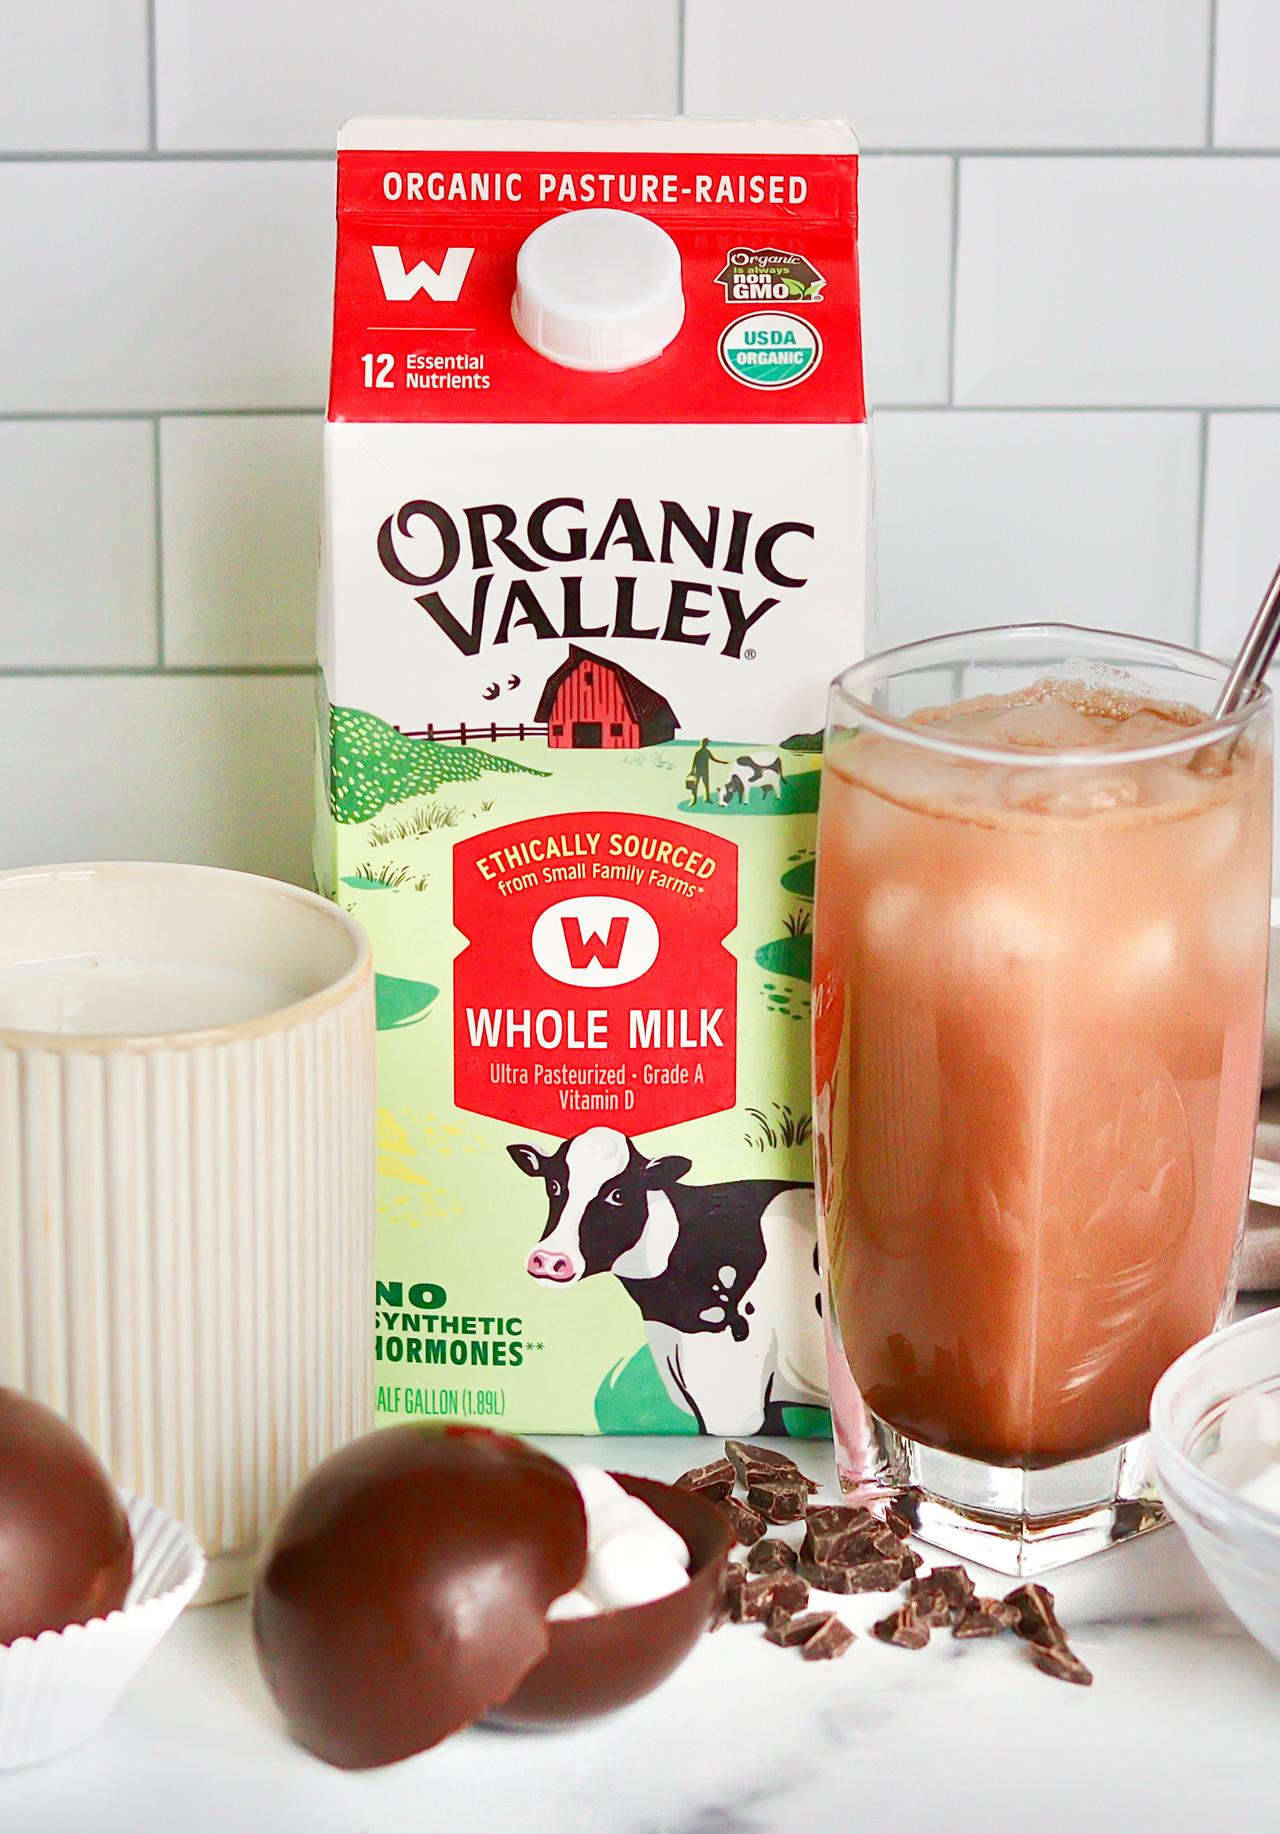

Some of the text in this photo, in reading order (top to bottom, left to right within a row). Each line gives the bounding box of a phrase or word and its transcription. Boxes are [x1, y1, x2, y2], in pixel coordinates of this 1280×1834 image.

[382, 171, 808, 204] ORGANIC PASTURE-RAISED
[371, 245, 475, 301] W
[730, 252, 801, 267] Organic
[747, 266, 790, 275] always
[733, 274, 772, 284] non
[733, 283, 789, 299] GMO
[744, 331, 796, 345] USDA
[361, 353, 484, 388] 12 Essential
[736, 351, 804, 365] ORGANIC
[406, 371, 491, 389] Nutrients
[377, 497, 815, 588] ORGANIC
[475, 833, 717, 881] ETHICALLY SOURCED
[498, 872, 539, 897] from
[542, 862, 586, 884] Small
[592, 862, 644, 885] Family
[560, 916, 629, 969] W
[466, 1007, 725, 1049] WHOLE MILK
[490, 1063, 704, 1086] Ultra Pasteurized Grade A
[559, 1089, 635, 1111] Vitamin D
[376, 1280, 447, 1310] NO
[376, 1386, 506, 1417] ALF GALLON (1.89L)
